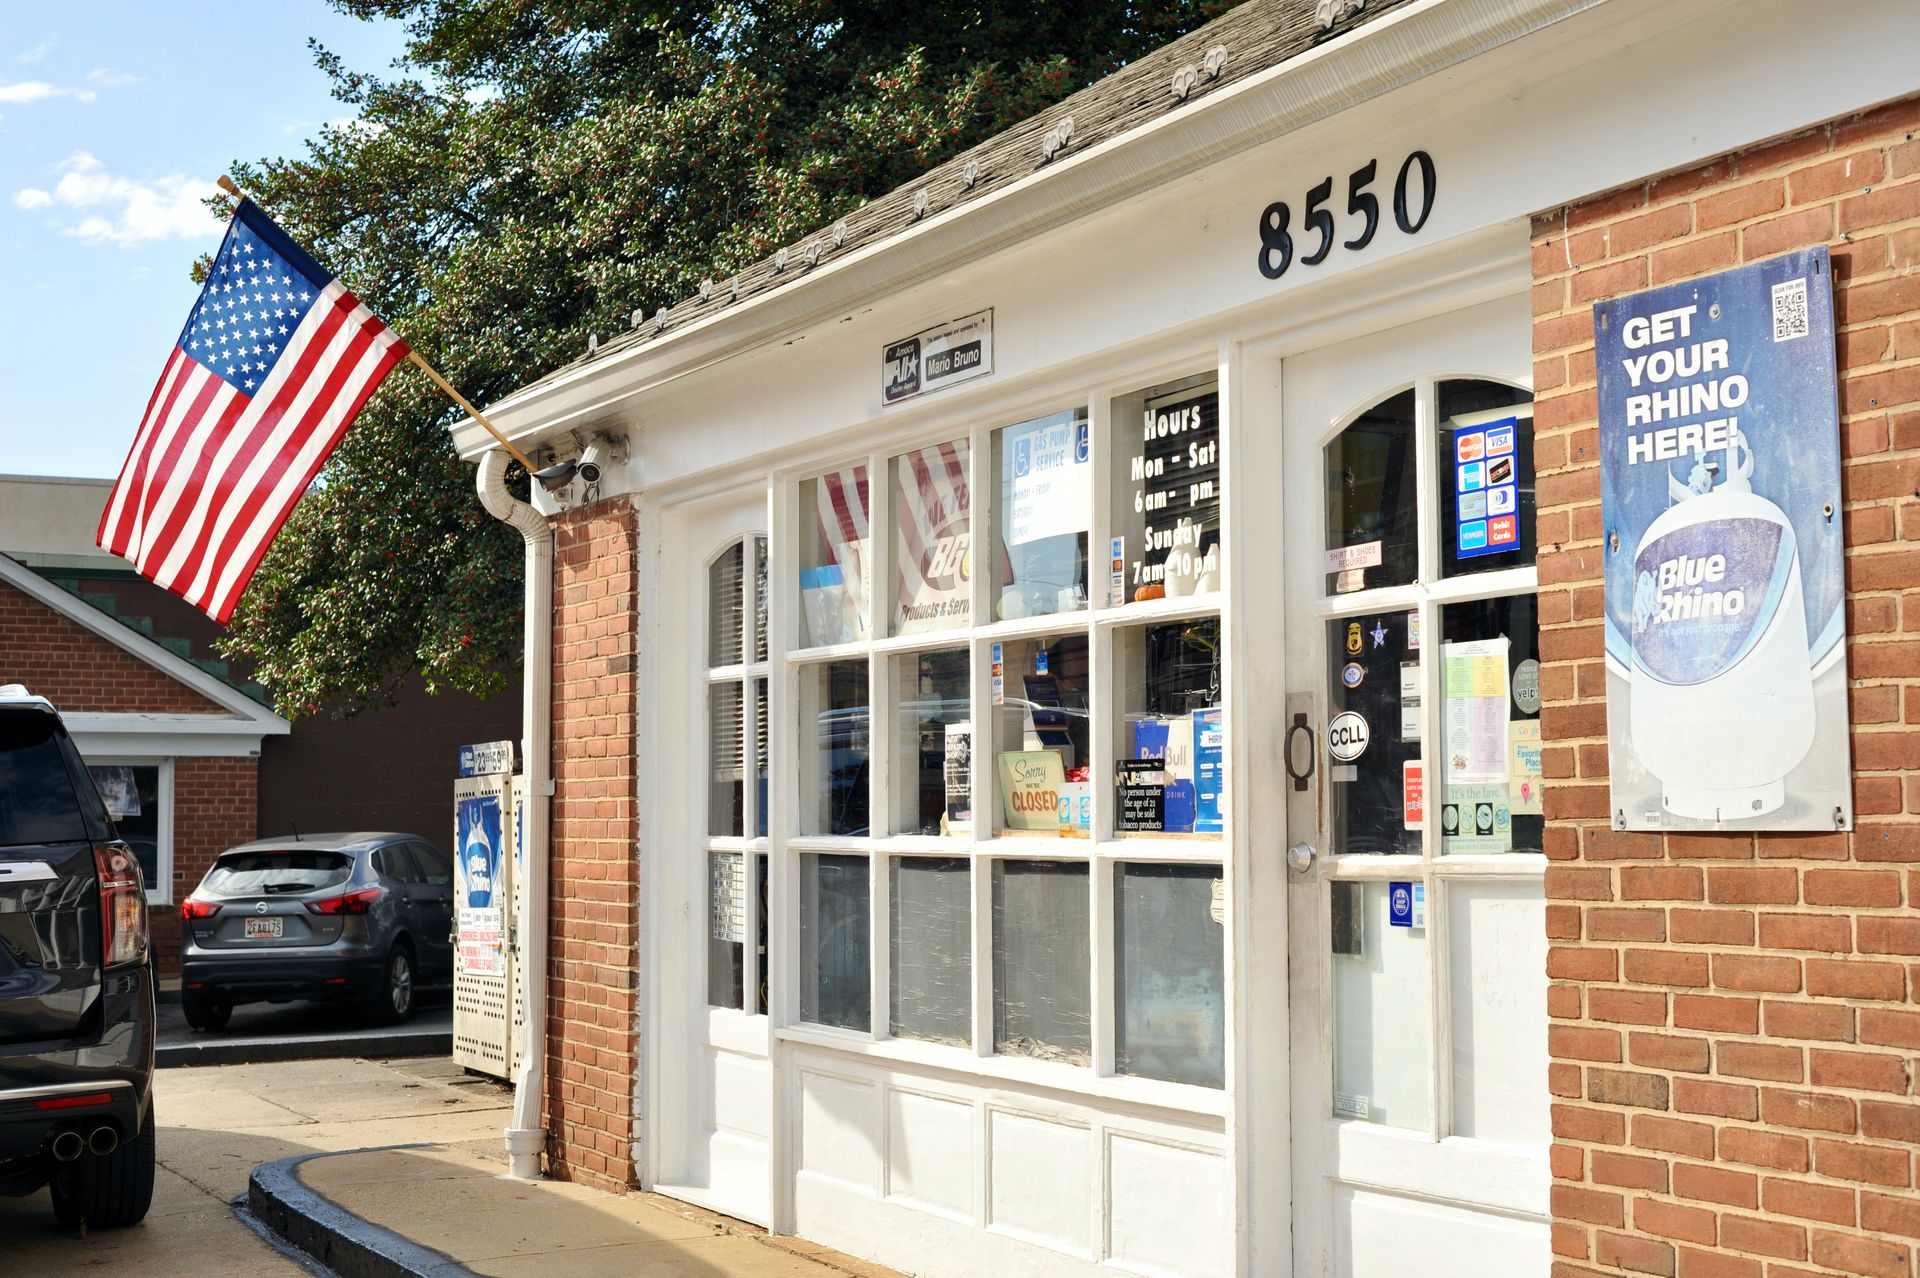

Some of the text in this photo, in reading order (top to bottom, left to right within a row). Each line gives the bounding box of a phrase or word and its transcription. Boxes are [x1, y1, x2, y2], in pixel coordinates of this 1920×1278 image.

[1258, 150, 1436, 280] 8550
[1622, 304, 1698, 350] GET
[895, 344, 915, 359] Amoco
[927, 348, 980, 377] Mario Bruno
[1622, 338, 1729, 388] YOUR
[1626, 374, 1749, 428] RHINO
[1144, 405, 1200, 442] Hours
[1034, 422, 1071, 453] GAS PUMP
[1491, 435, 1508, 448] VISA
[1627, 416, 1739, 466] HERE!
[1036, 449, 1064, 473] SERVICE
[1131, 455, 1164, 482] Mon
[1188, 440, 1216, 479] Sat
[1144, 518, 1202, 552] Sunday
[1493, 520, 1510, 531] Debit
[1493, 531, 1511, 541] Cards
[1329, 545, 1376, 561] SHIRT & SHOES
[1338, 555, 1368, 569] REQUIRED
[1659, 553, 1726, 590] Blue
[902, 600, 939, 622] Products
[940, 603, 947, 615] &
[1653, 588, 1745, 625] Rhino
[1658, 627, 1670, 637] It's
[1670, 626, 1684, 636] not
[1685, 624, 1701, 637] just
[1517, 687, 1535, 700] yelp
[1329, 725, 1365, 748] CCLL
[1165, 745, 1187, 767] Bull
[1015, 759, 1046, 783] Sorry
[1011, 790, 1059, 812] CLOSED
[1119, 786, 1162, 799] No person under
[1124, 798, 1132, 807] the
[1133, 800, 1142, 809] age
[1143, 797, 1149, 807] of
[1166, 791, 1186, 799] DRINK
[1451, 788, 1465, 800] It's
[1466, 787, 1481, 799] the
[1119, 819, 1162, 831] tobacco products
[1125, 808, 1156, 820] may be sold
[470, 855, 487, 873] Blue
